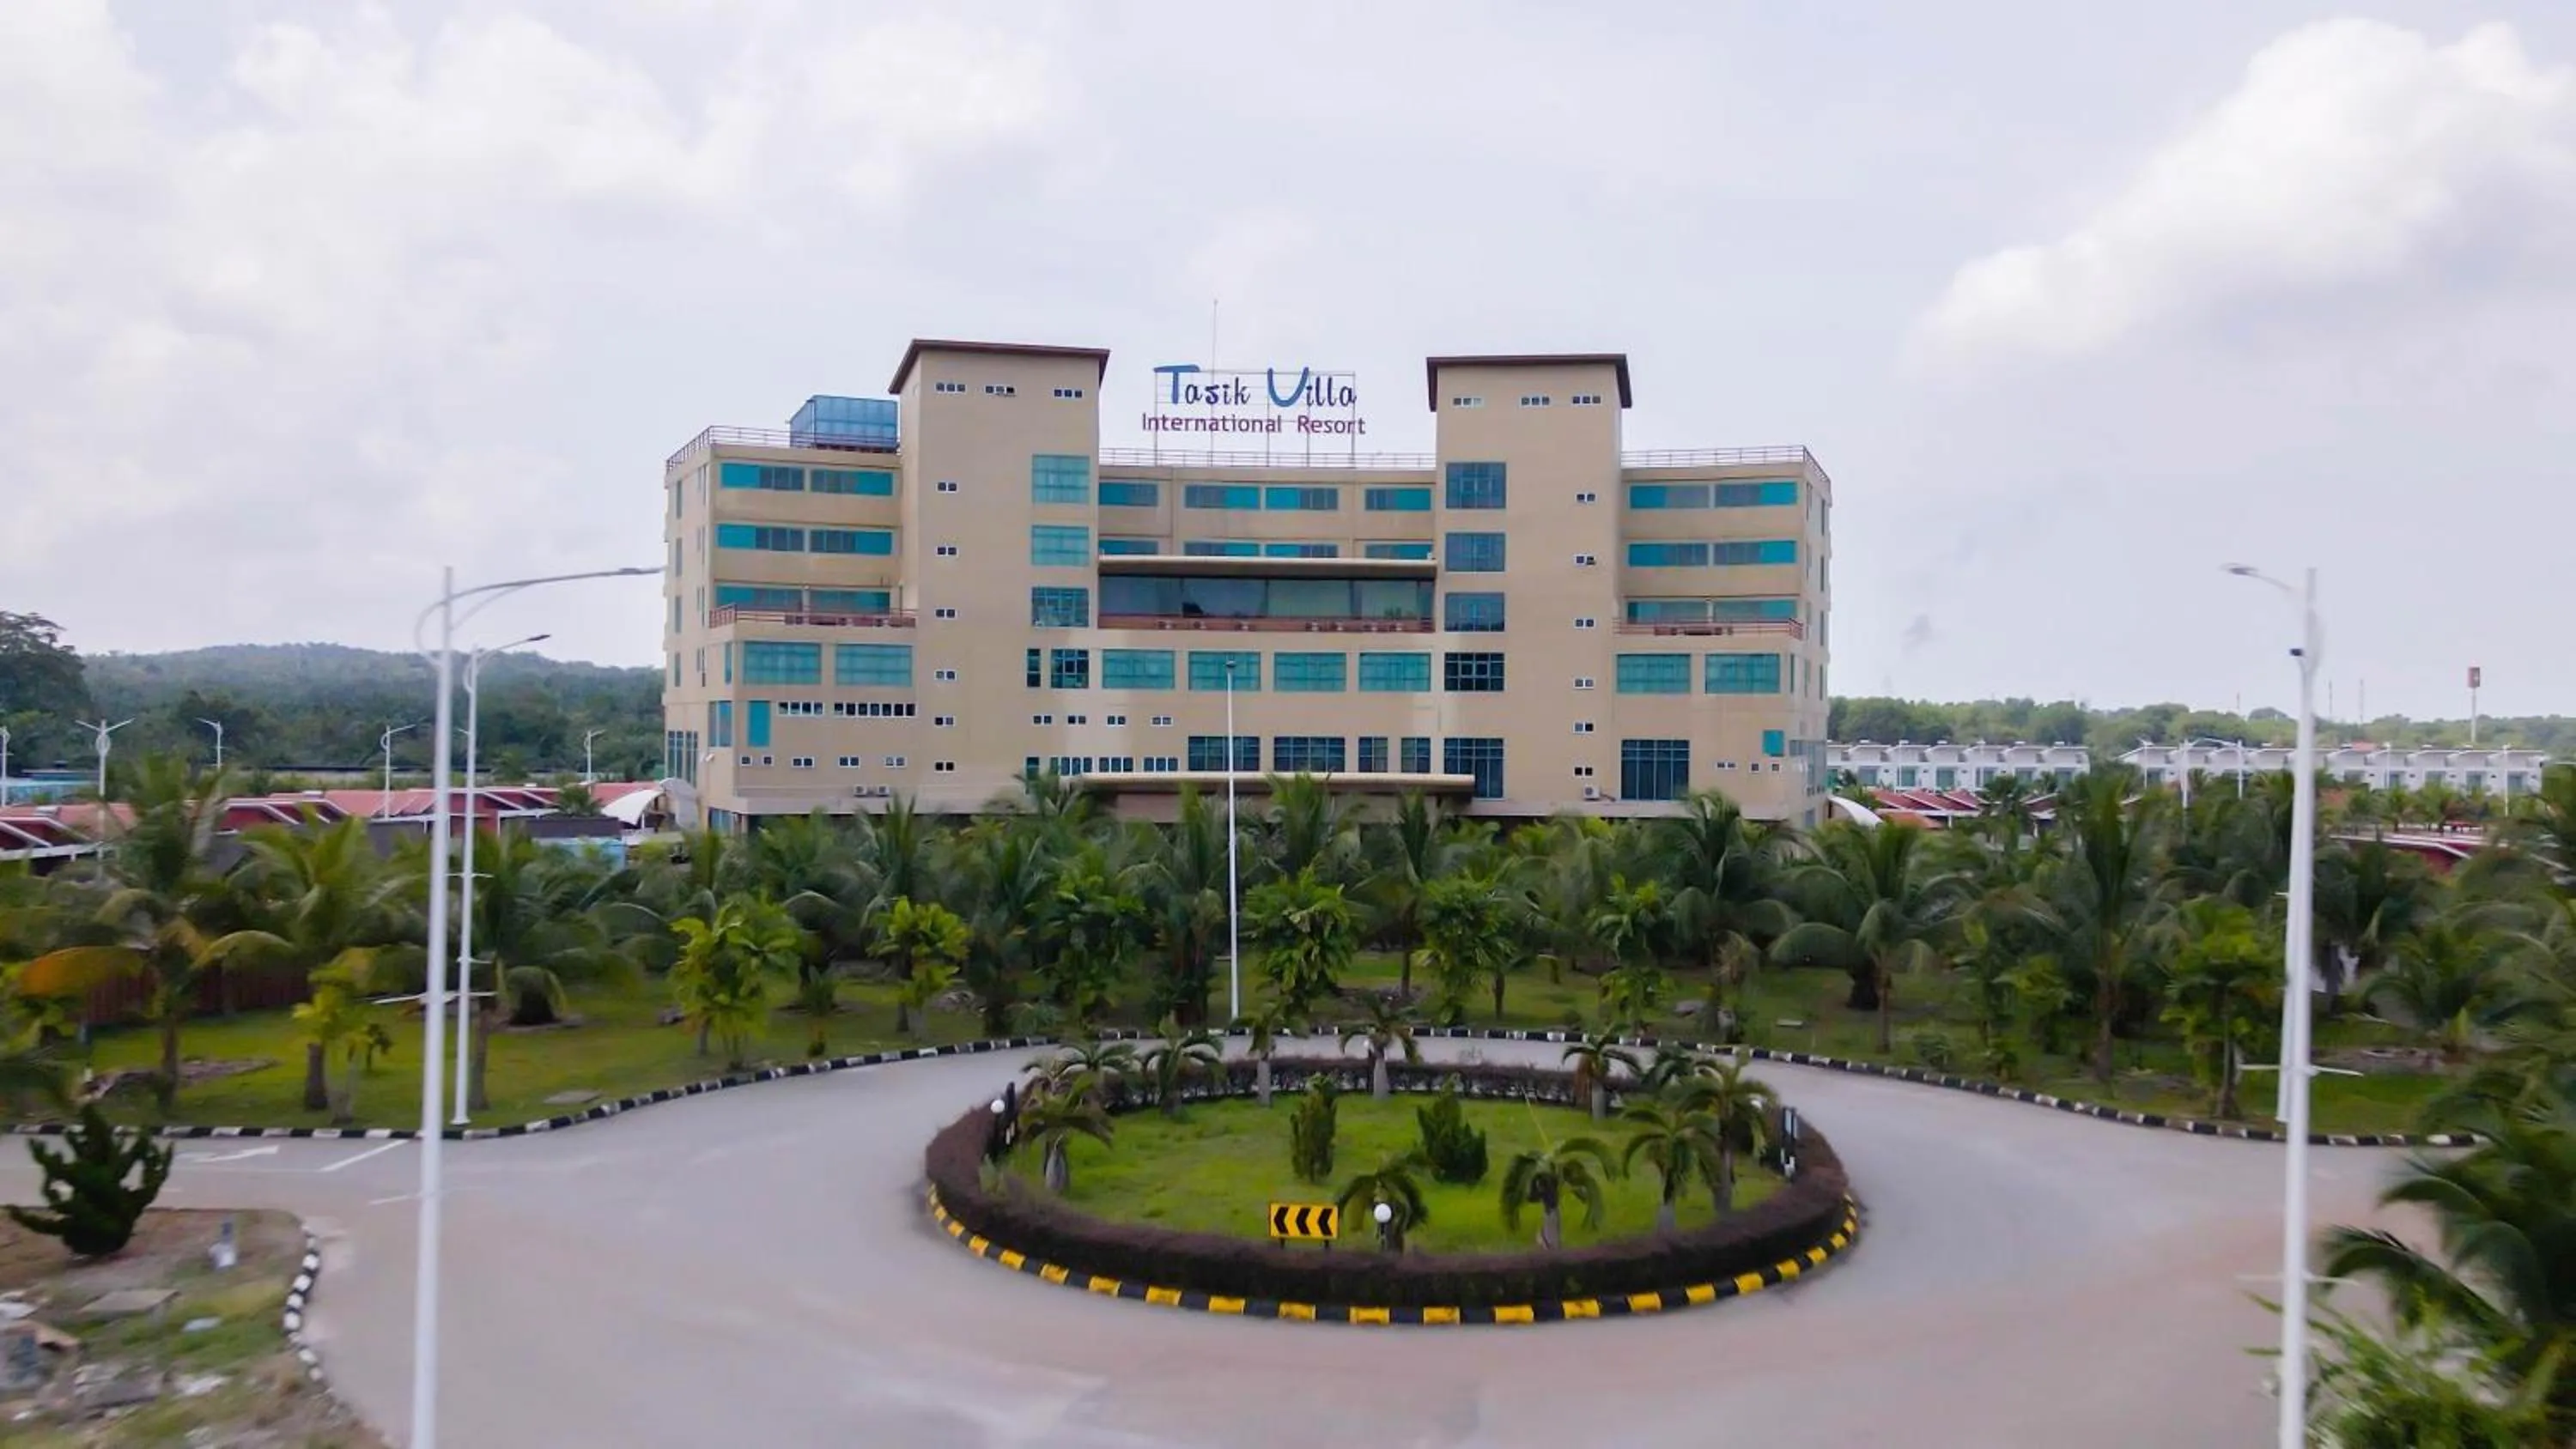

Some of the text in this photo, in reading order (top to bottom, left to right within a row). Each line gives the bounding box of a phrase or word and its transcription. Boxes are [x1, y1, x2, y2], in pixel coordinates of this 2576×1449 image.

[1153, 364, 1251, 405] Tasik
[1143, 413, 1366, 434] International Resort
